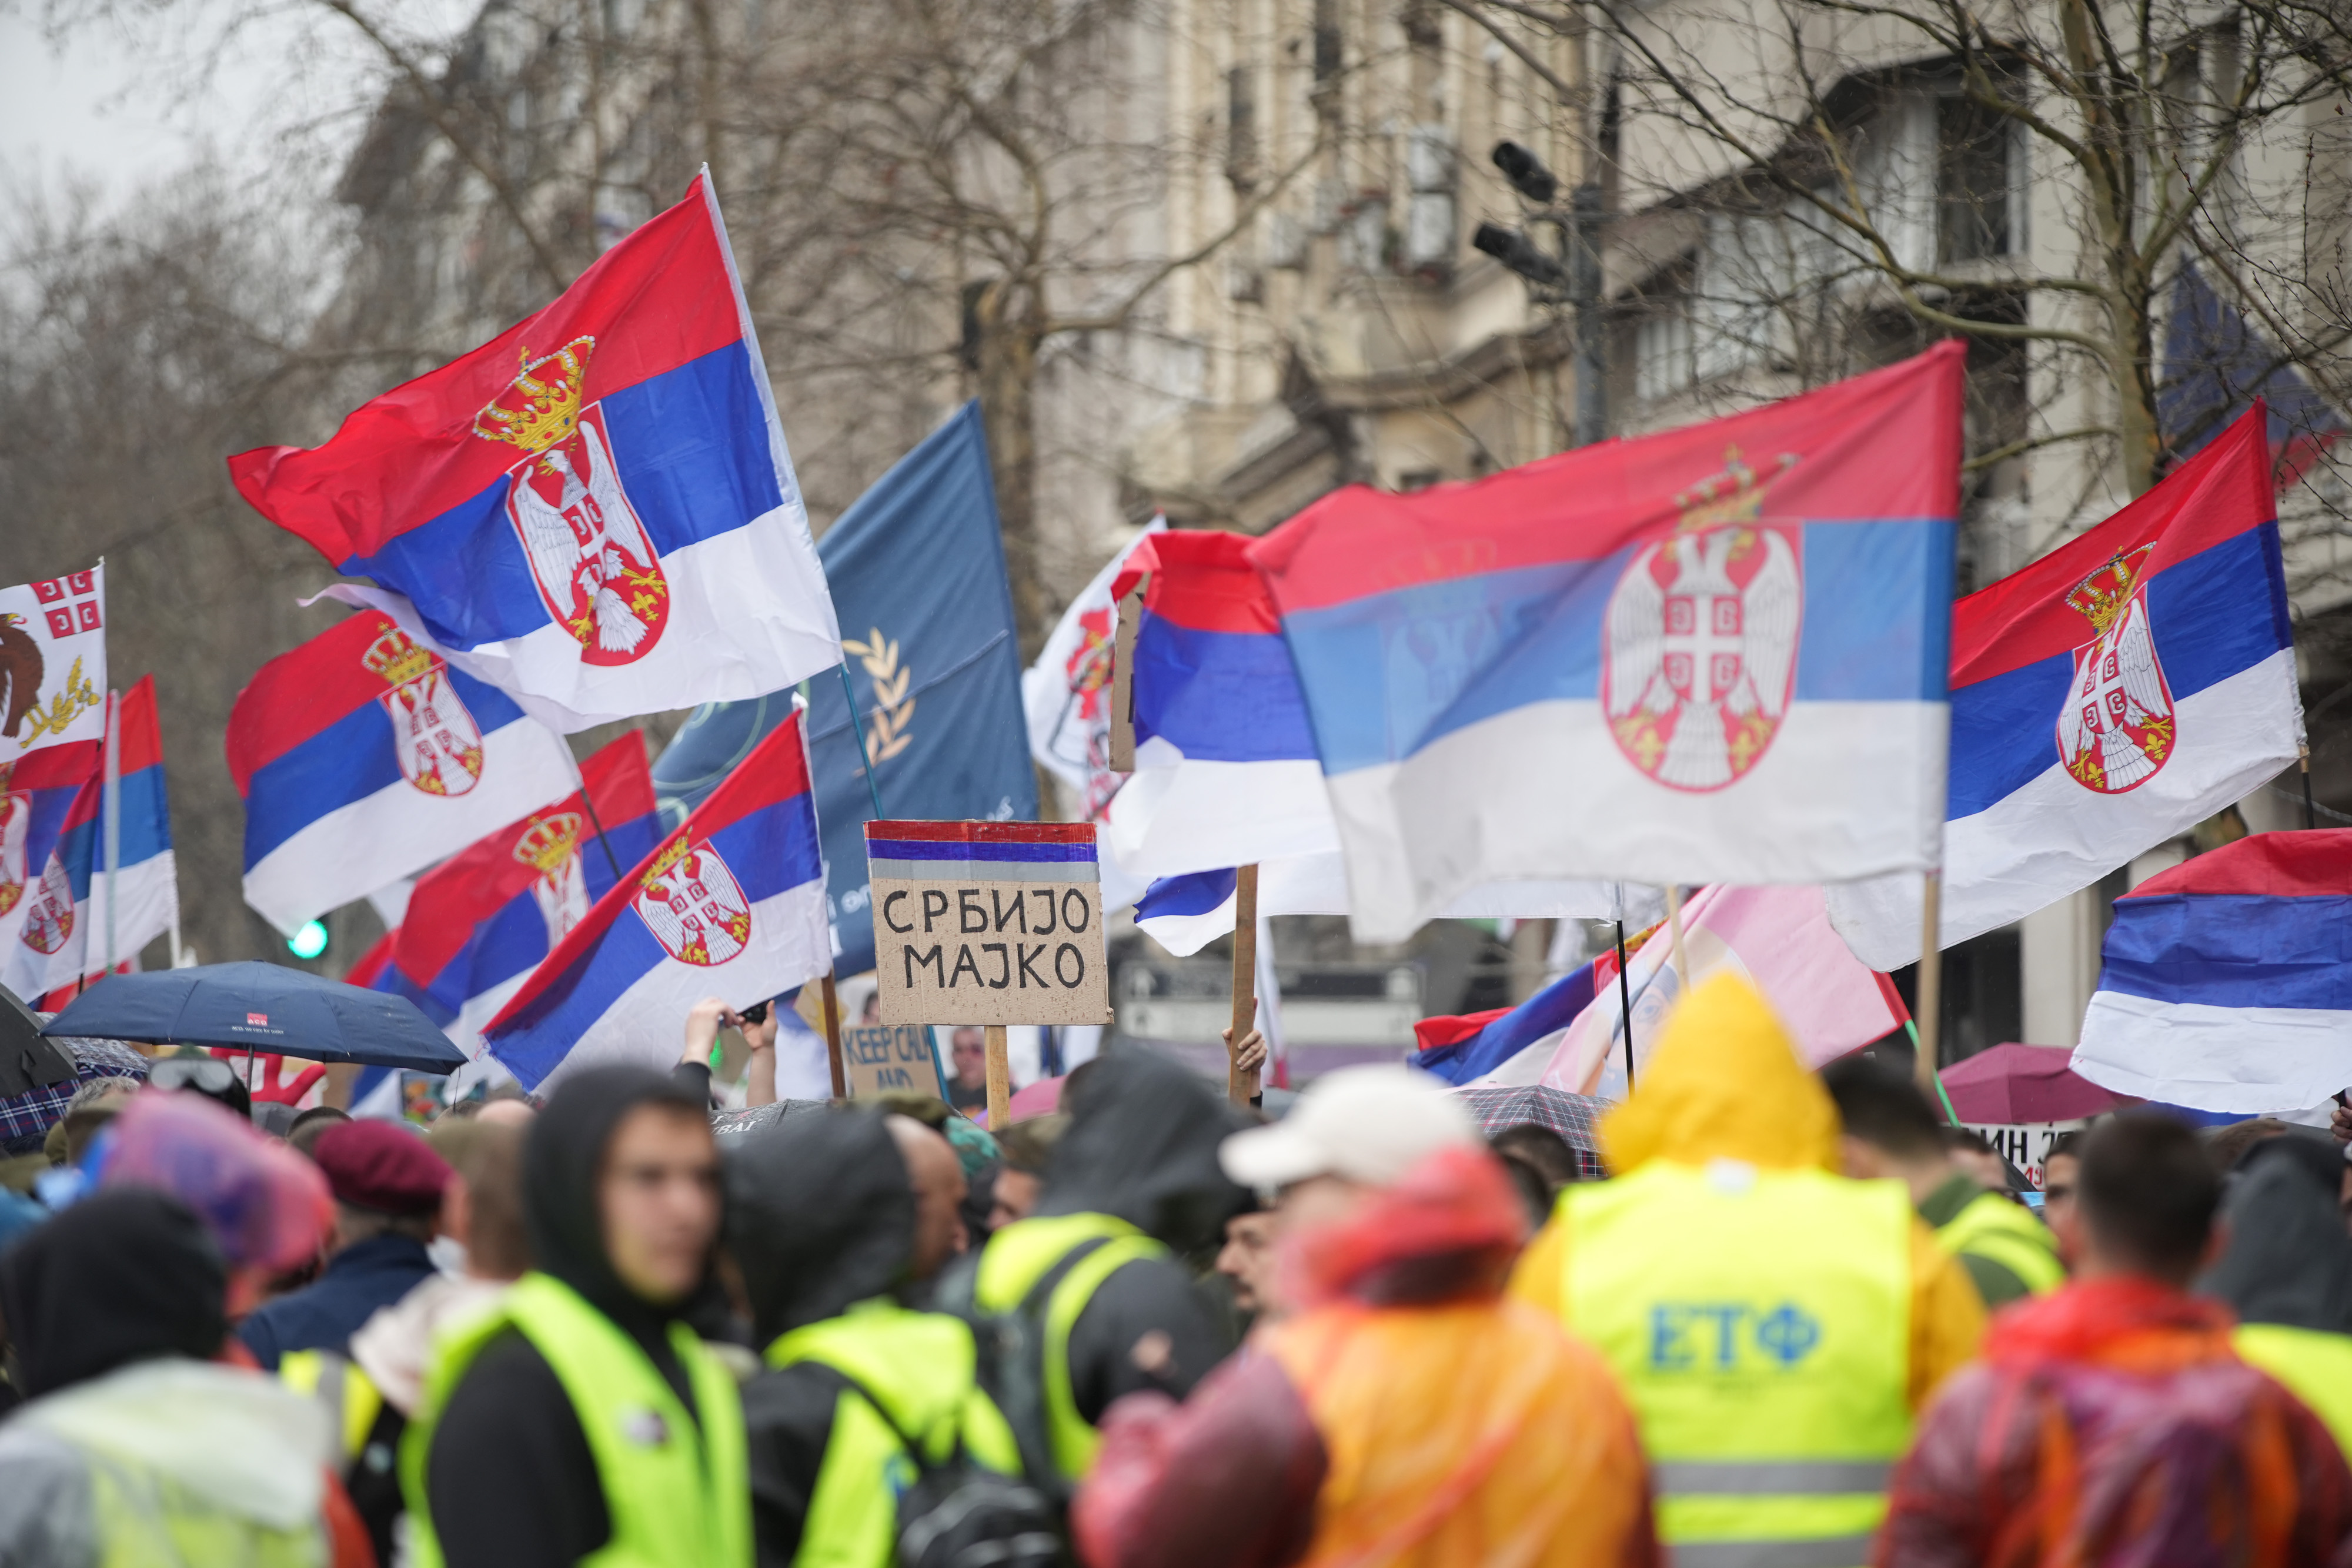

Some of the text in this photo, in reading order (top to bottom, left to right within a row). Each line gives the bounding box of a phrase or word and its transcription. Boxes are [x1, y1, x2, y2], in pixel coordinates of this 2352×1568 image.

[883, 888, 1090, 935] СРБИЈО
[904, 942, 1085, 989] МАЈКО
[841, 1027, 892, 1065] KEEP
[1651, 1302, 1820, 1370] ЕТФ
